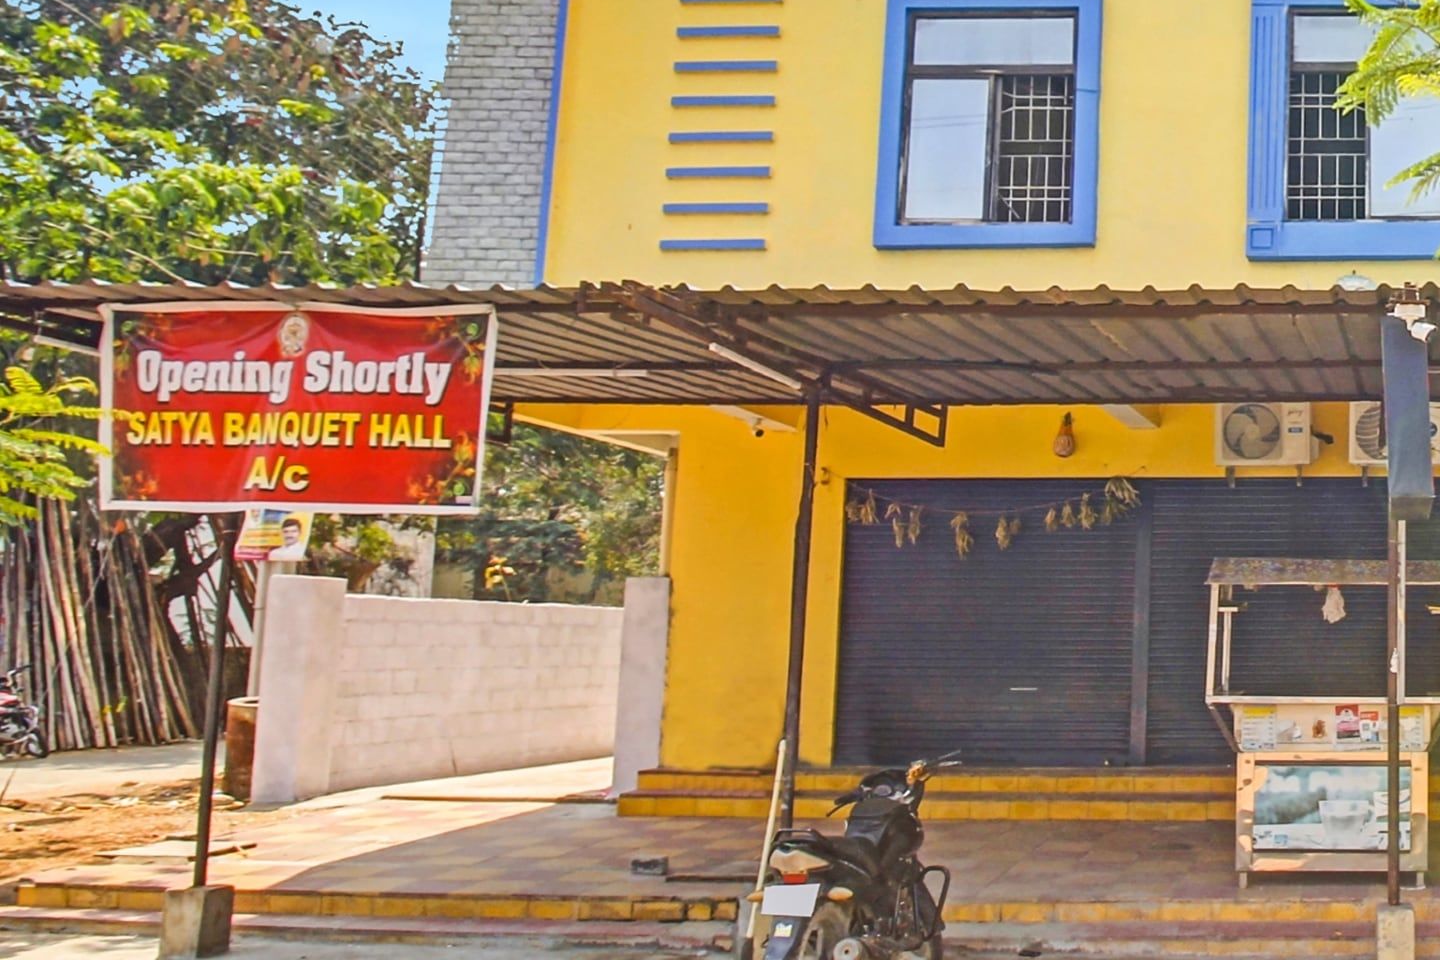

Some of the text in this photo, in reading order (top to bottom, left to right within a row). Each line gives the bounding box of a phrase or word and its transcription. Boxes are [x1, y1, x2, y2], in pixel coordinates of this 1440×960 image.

[136, 349, 452, 405] Opening Shortly
[126, 410, 452, 449] SATYA BANQUET HALL
